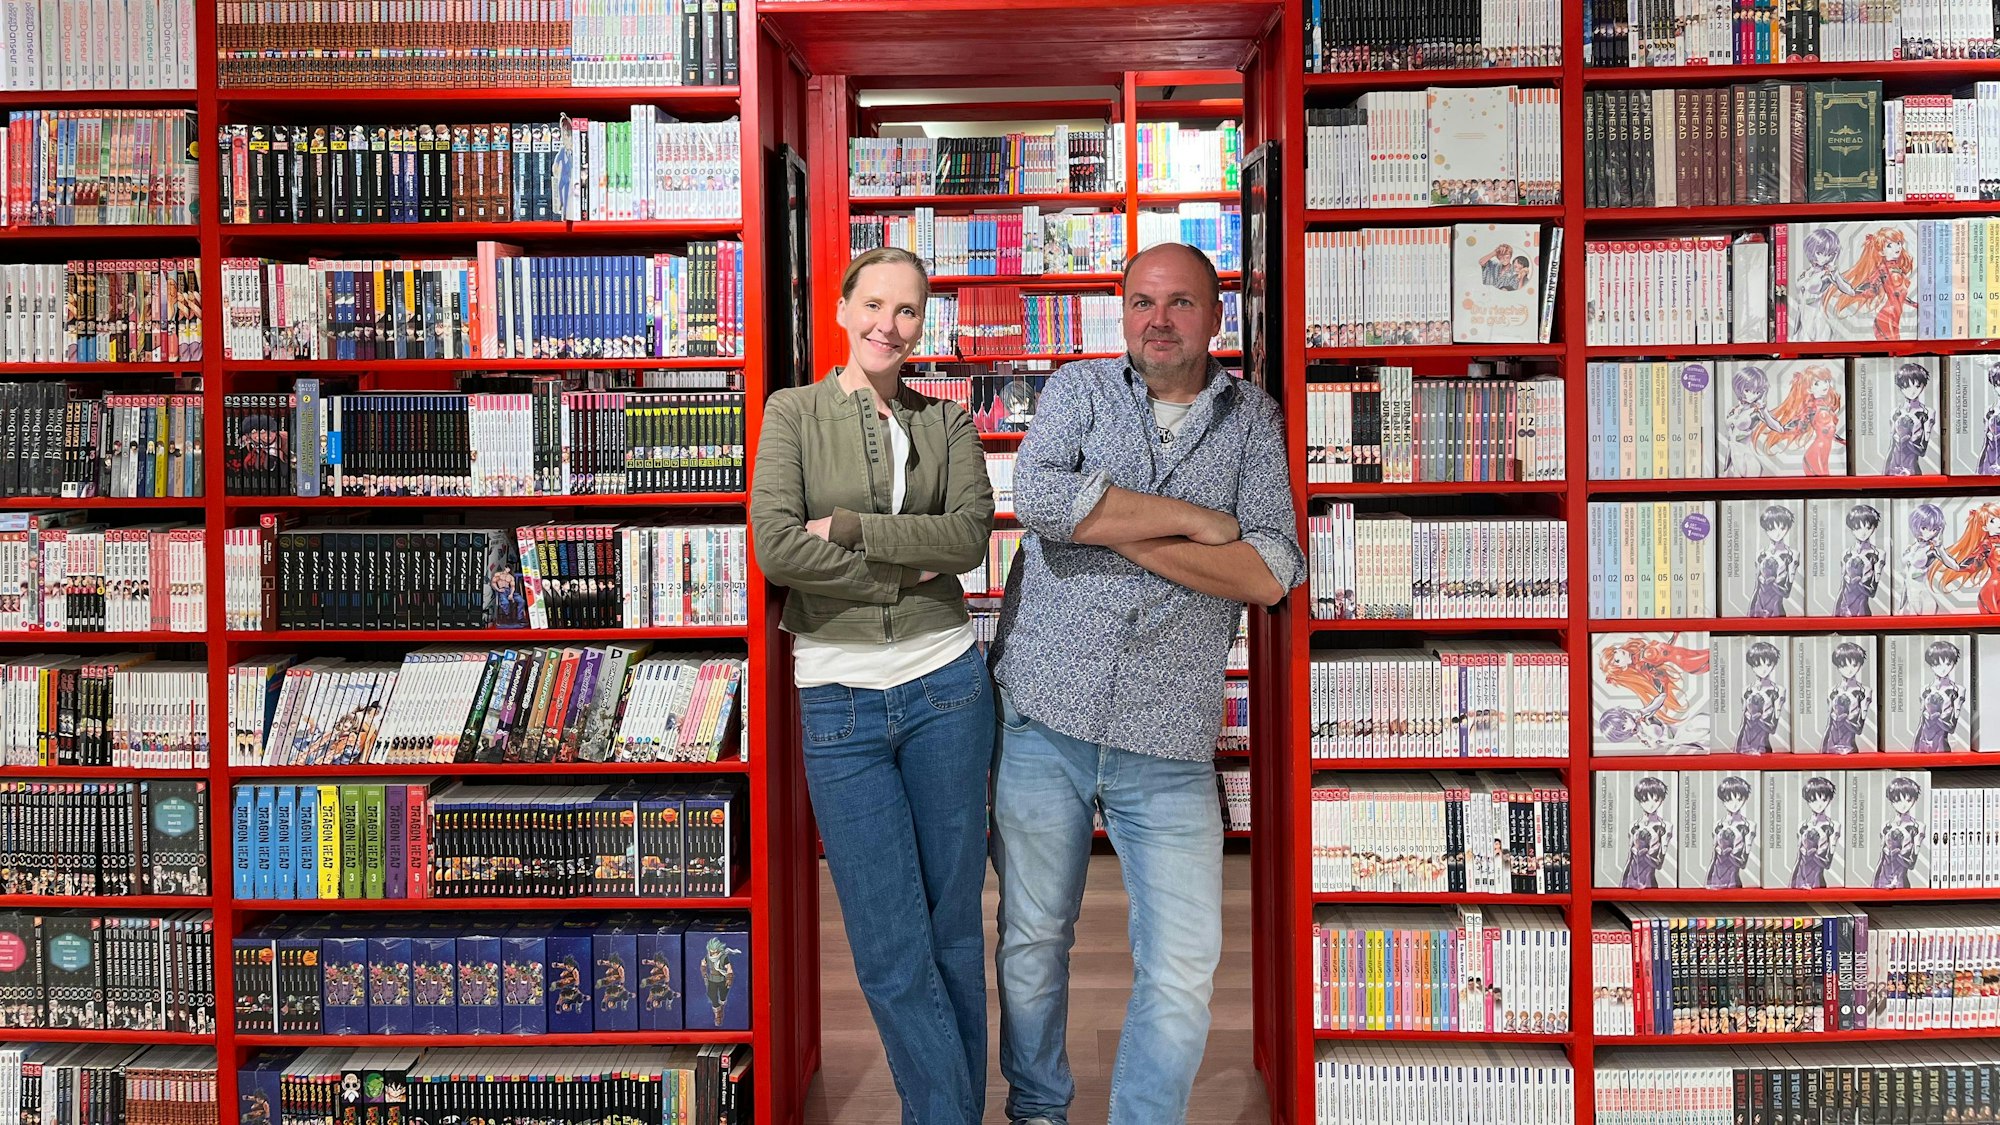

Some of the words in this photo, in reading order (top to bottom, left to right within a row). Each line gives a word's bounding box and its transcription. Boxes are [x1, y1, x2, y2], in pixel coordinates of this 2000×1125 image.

[1691, 95, 1699, 139] ENNEAD
[1736, 92, 1745, 137] ENNEAD
[1748, 91, 1756, 136] ENNEAD
[1672, 434, 1681, 442] 06
[66, 451, 69, 460] 1
[73, 451, 77, 460] 1
[90, 451, 95, 459] 3
[1641, 574, 1651, 582] 04
[1658, 573, 1668, 581] 05
[237, 806, 248, 841] DRAGON
[258, 807, 269, 842] DRAGON
[279, 806, 289, 841] DRAGON
[300, 807, 311, 841] DRAGON
[322, 806, 332, 841] DRAGON
[346, 805, 356, 841] DRAGON
[367, 806, 378, 841] DRAGON
[390, 806, 400, 841] DRAGON
[411, 806, 421, 841] DRAGON
[239, 846, 248, 869] HEAD
[259, 846, 269, 869] HEAD
[279, 846, 289, 869] HEAD
[302, 846, 311, 869] HEAD
[323, 846, 332, 868] HEAD
[346, 845, 356, 868] HEAD
[368, 845, 377, 868] HEAD
[390, 845, 400, 868] HEAD
[411, 844, 421, 868] HEAD
[349, 873, 354, 881] 3
[371, 874, 376, 882] 3
[414, 873, 419, 882] 5
[1839, 951, 1852, 990] EXISTENCE
[1855, 951, 1868, 990] EXISTENCE
